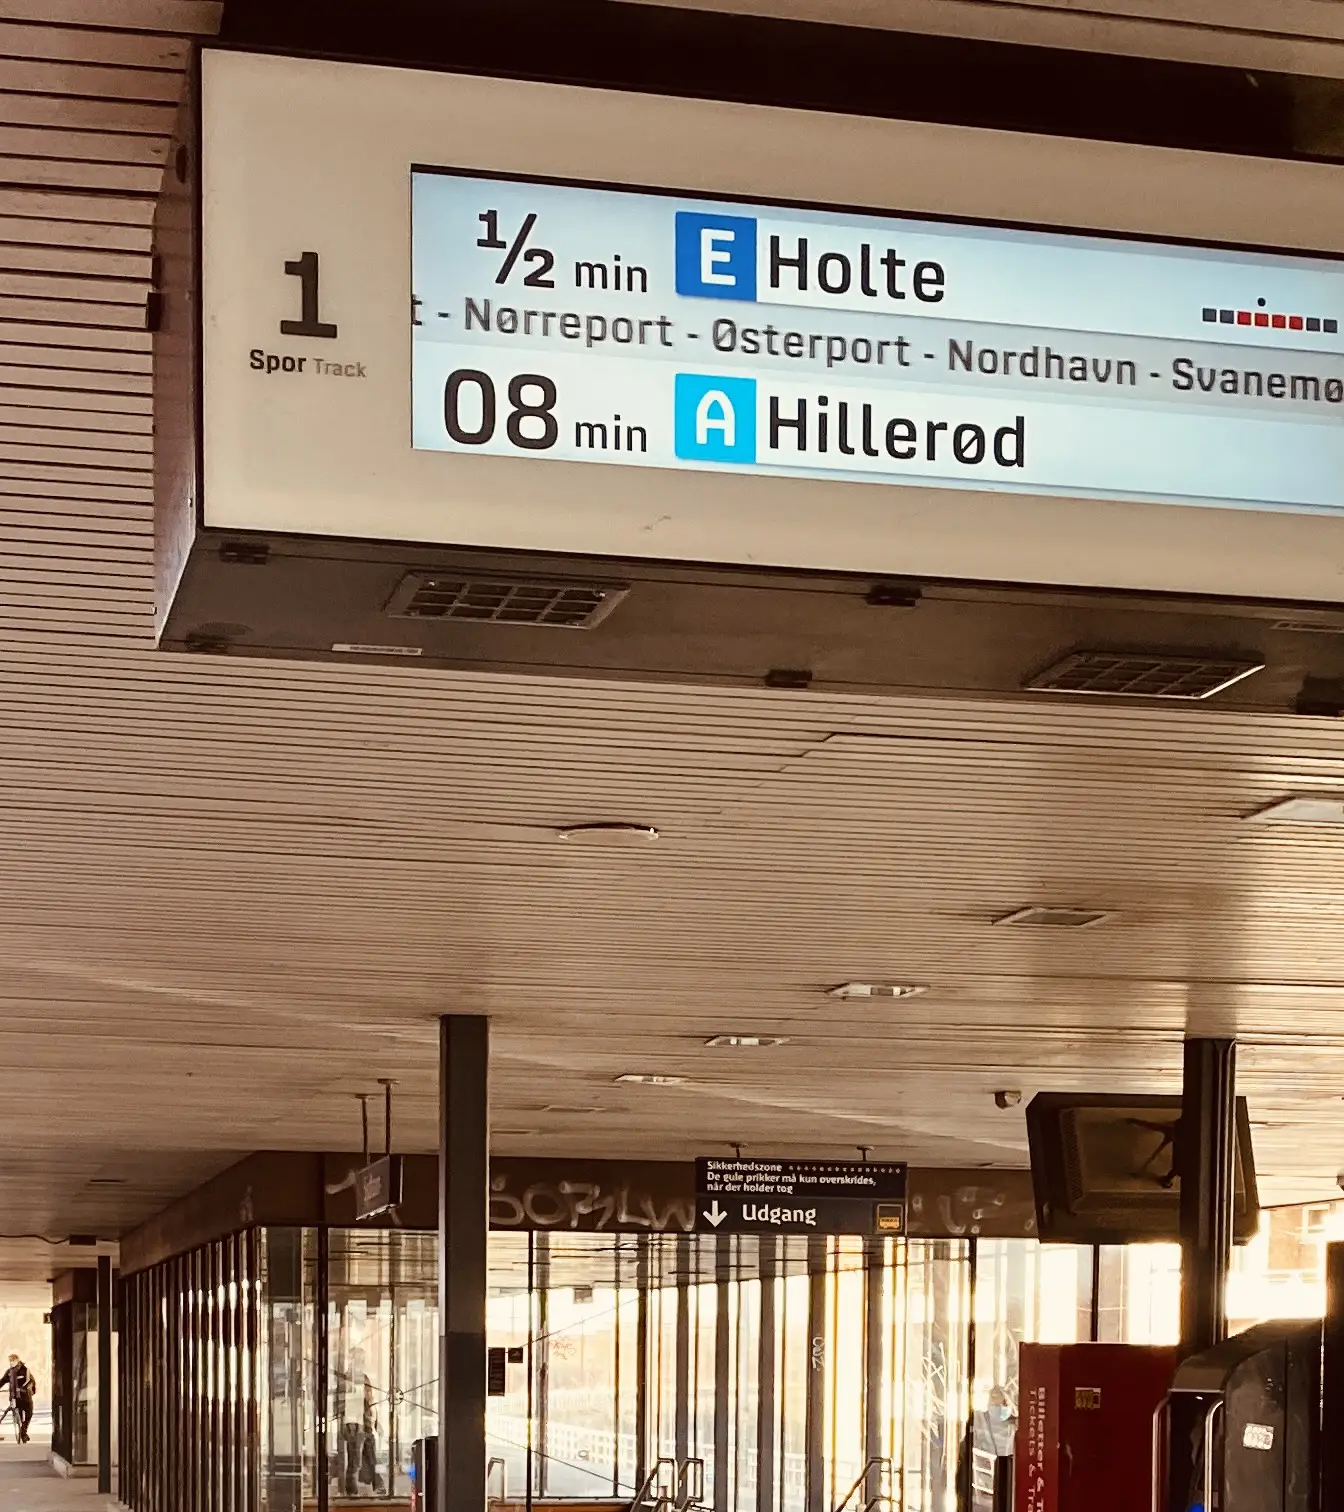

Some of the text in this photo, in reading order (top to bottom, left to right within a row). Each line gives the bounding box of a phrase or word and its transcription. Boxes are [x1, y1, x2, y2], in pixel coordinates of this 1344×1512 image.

[575, 255, 647, 293] min
[699, 228, 737, 287] E
[769, 235, 946, 303] Holte
[280, 251, 338, 338] 1
[249, 349, 368, 378] Spor Track
[464, 297, 673, 348] Nørreport
[712, 317, 911, 368] Østerport
[948, 338, 1137, 386] Nordhavn
[444, 368, 1025, 468] 08 min A Hillerød
[706, 1160, 783, 1172] Sikkerhedszone
[707, 1171, 721, 1181] De
[723, 1173, 744, 1184] gule
[746, 1172, 781, 1185] prikker
[782, 1173, 797, 1183] må
[799, 1174, 817, 1184] kun
[707, 1182, 793, 1195] når der holder tog
[742, 1204, 817, 1226] Udgang
[1028, 1389, 1037, 1457] Tickets
